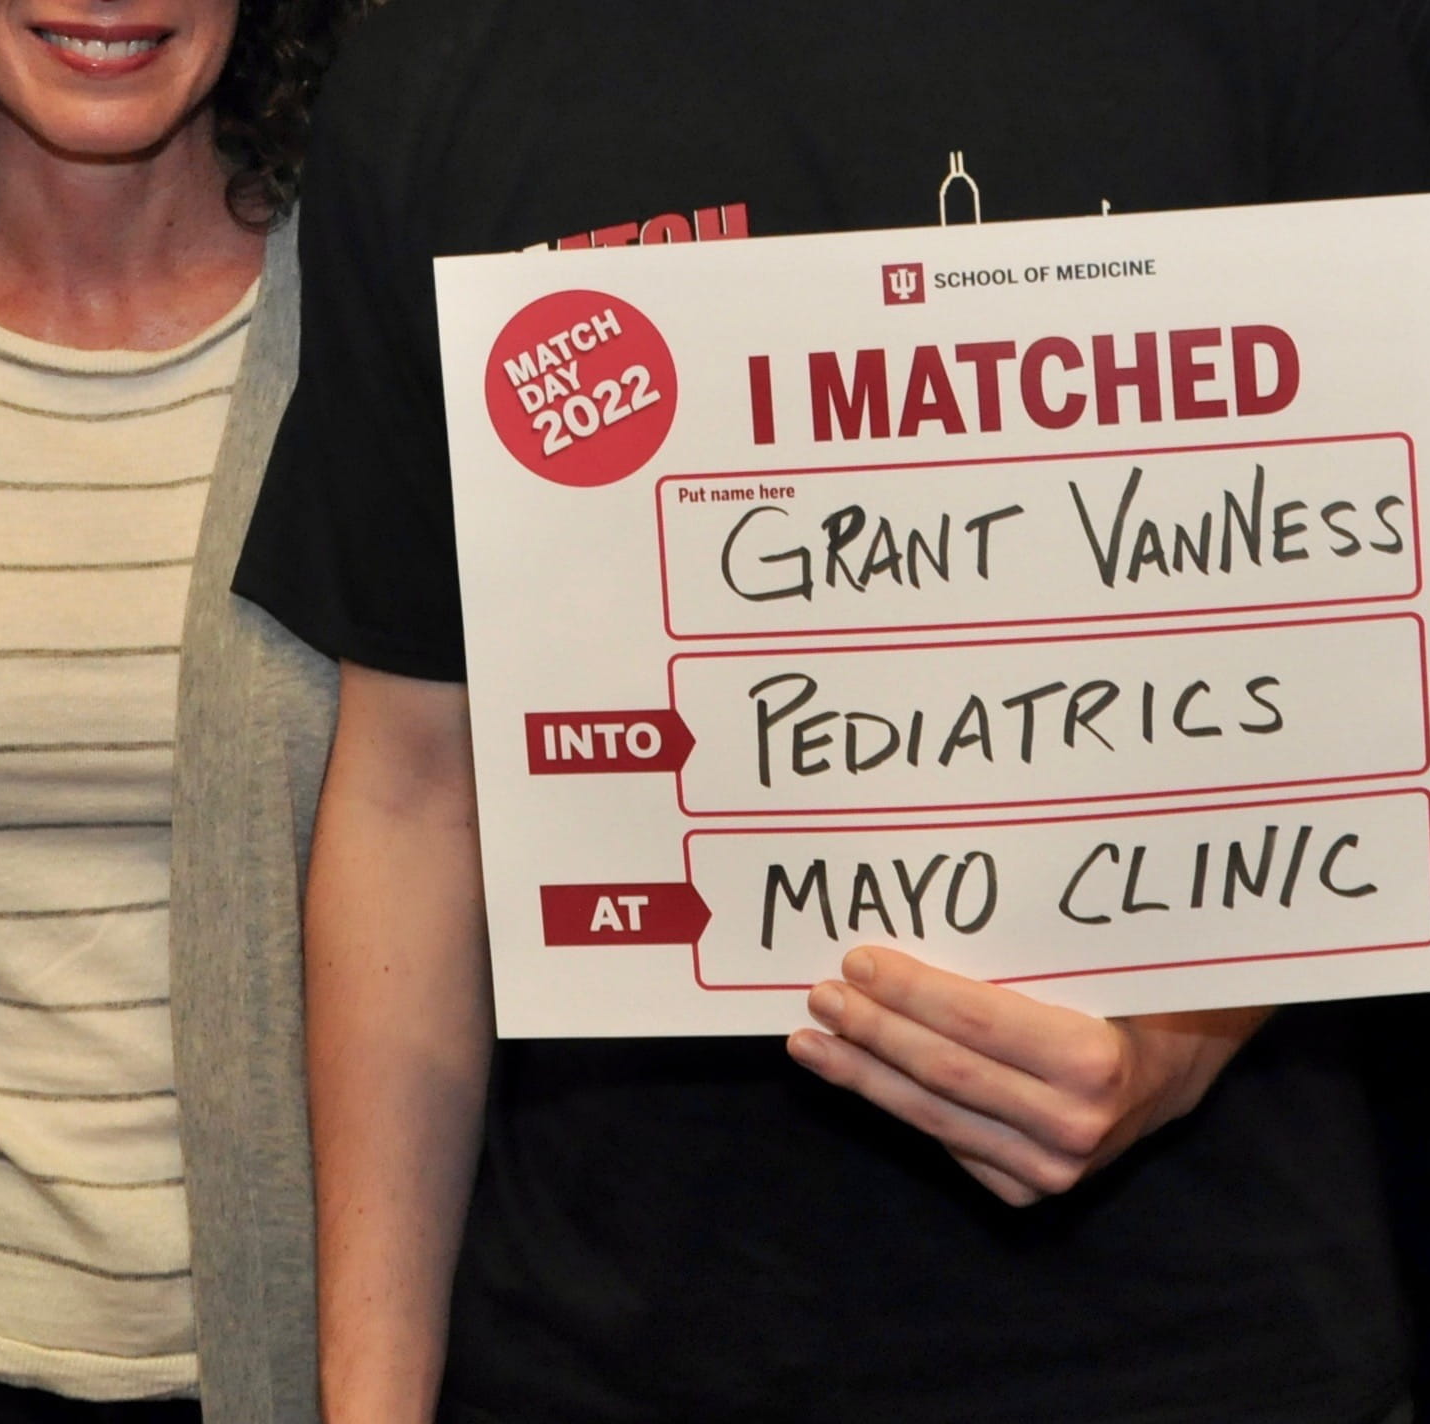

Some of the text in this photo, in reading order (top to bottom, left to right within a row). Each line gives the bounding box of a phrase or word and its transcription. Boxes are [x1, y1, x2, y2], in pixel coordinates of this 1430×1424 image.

[934, 268, 1019, 289] SCHOOL
[1024, 266, 1050, 283] OF
[1056, 259, 1157, 281] MEDICINE
[503, 308, 622, 387] MATCH
[517, 360, 581, 414] DAY
[748, 324, 1300, 445] I MATCHED
[532, 364, 661, 457] 2022
[678, 484, 795, 503] Put name here
[721, 504, 1024, 602] GRANT
[542, 723, 662, 760] INTO
[748, 672, 1285, 788] PEDIATRICS
[589, 895, 649, 932] AT
[761, 824, 1378, 950] MAYO CLINIC
